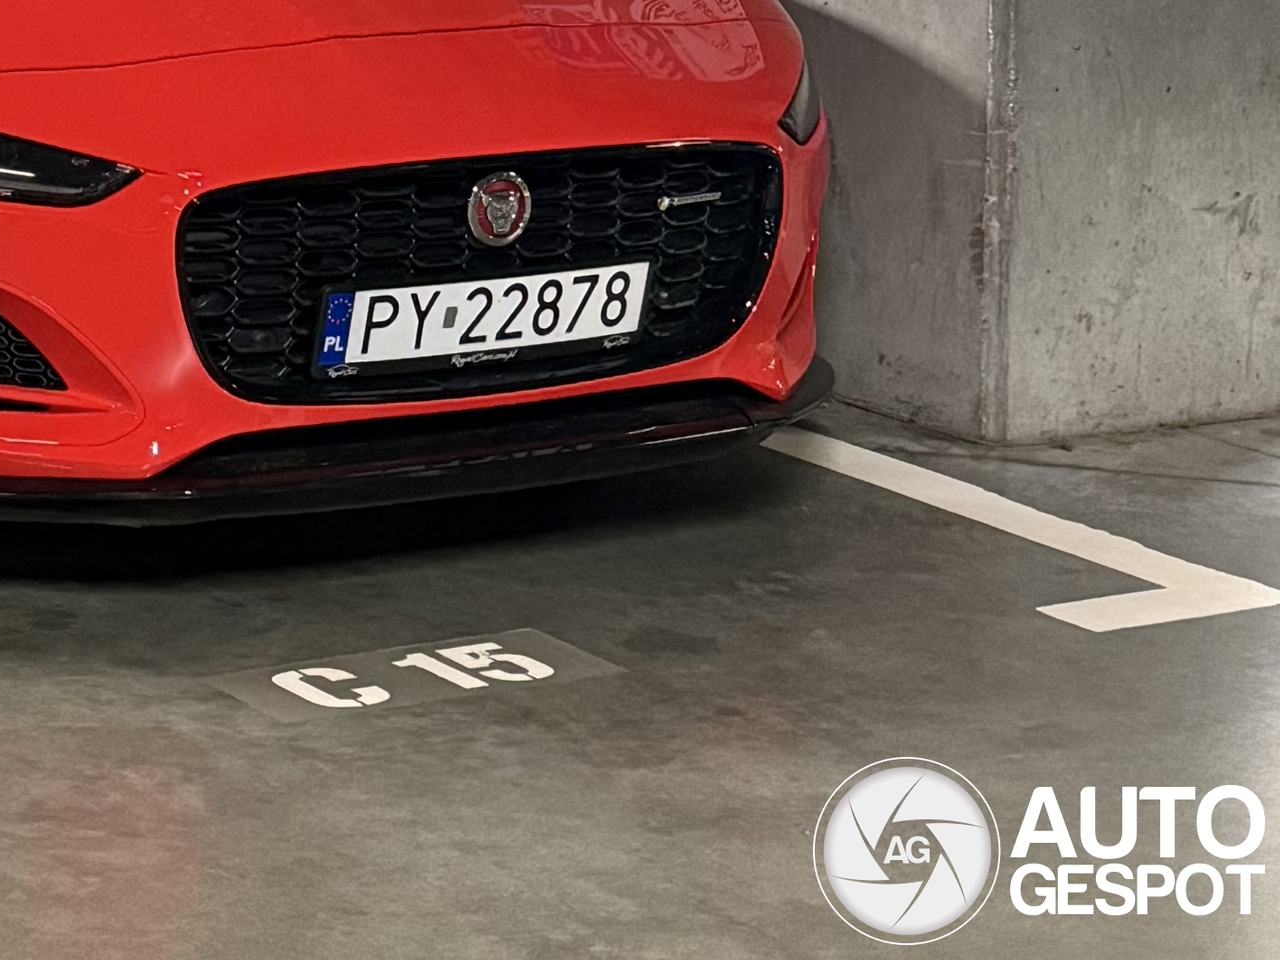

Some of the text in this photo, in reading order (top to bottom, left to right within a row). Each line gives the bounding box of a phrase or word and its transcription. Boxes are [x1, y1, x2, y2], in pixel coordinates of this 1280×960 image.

[323, 335, 344, 353] PL
[361, 270, 631, 354] PY 22878
[271, 642, 555, 708] C 15
